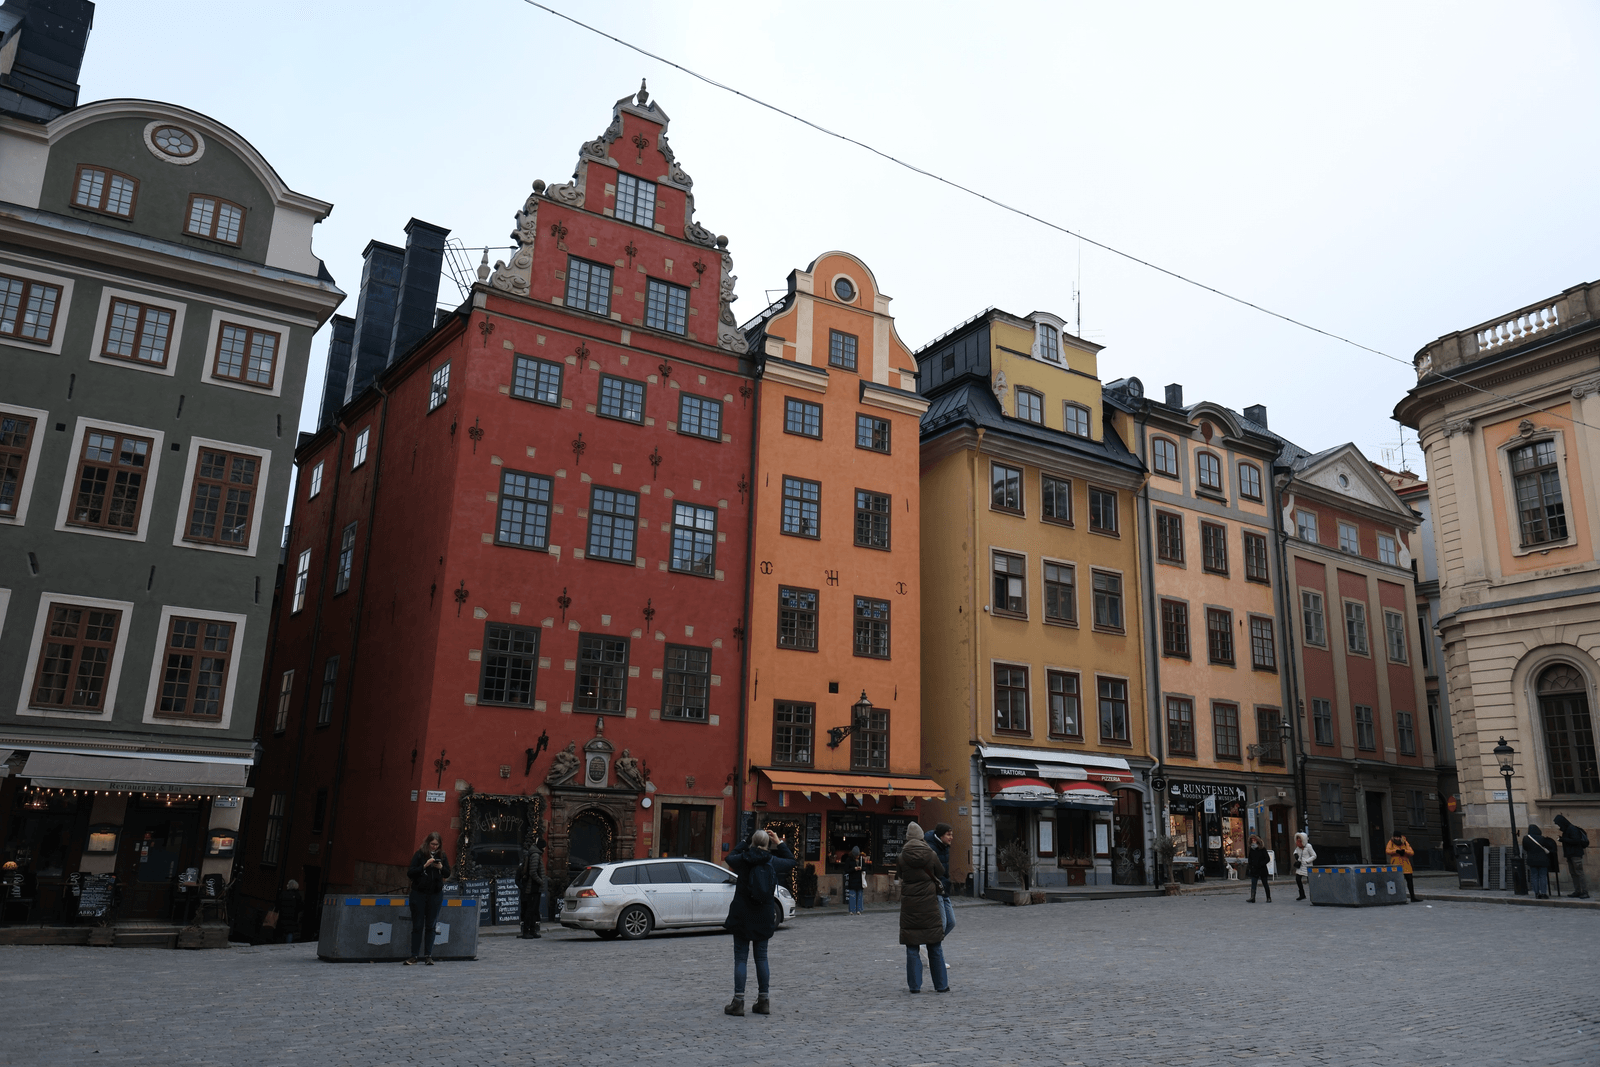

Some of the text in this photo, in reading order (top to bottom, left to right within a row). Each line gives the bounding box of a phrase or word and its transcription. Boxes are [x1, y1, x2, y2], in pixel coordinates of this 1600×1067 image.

[1000, 769, 1026, 777] TRATTORIA
[109, 782, 157, 792] Restaurang
[1183, 783, 1234, 796] RUNSTENEN
